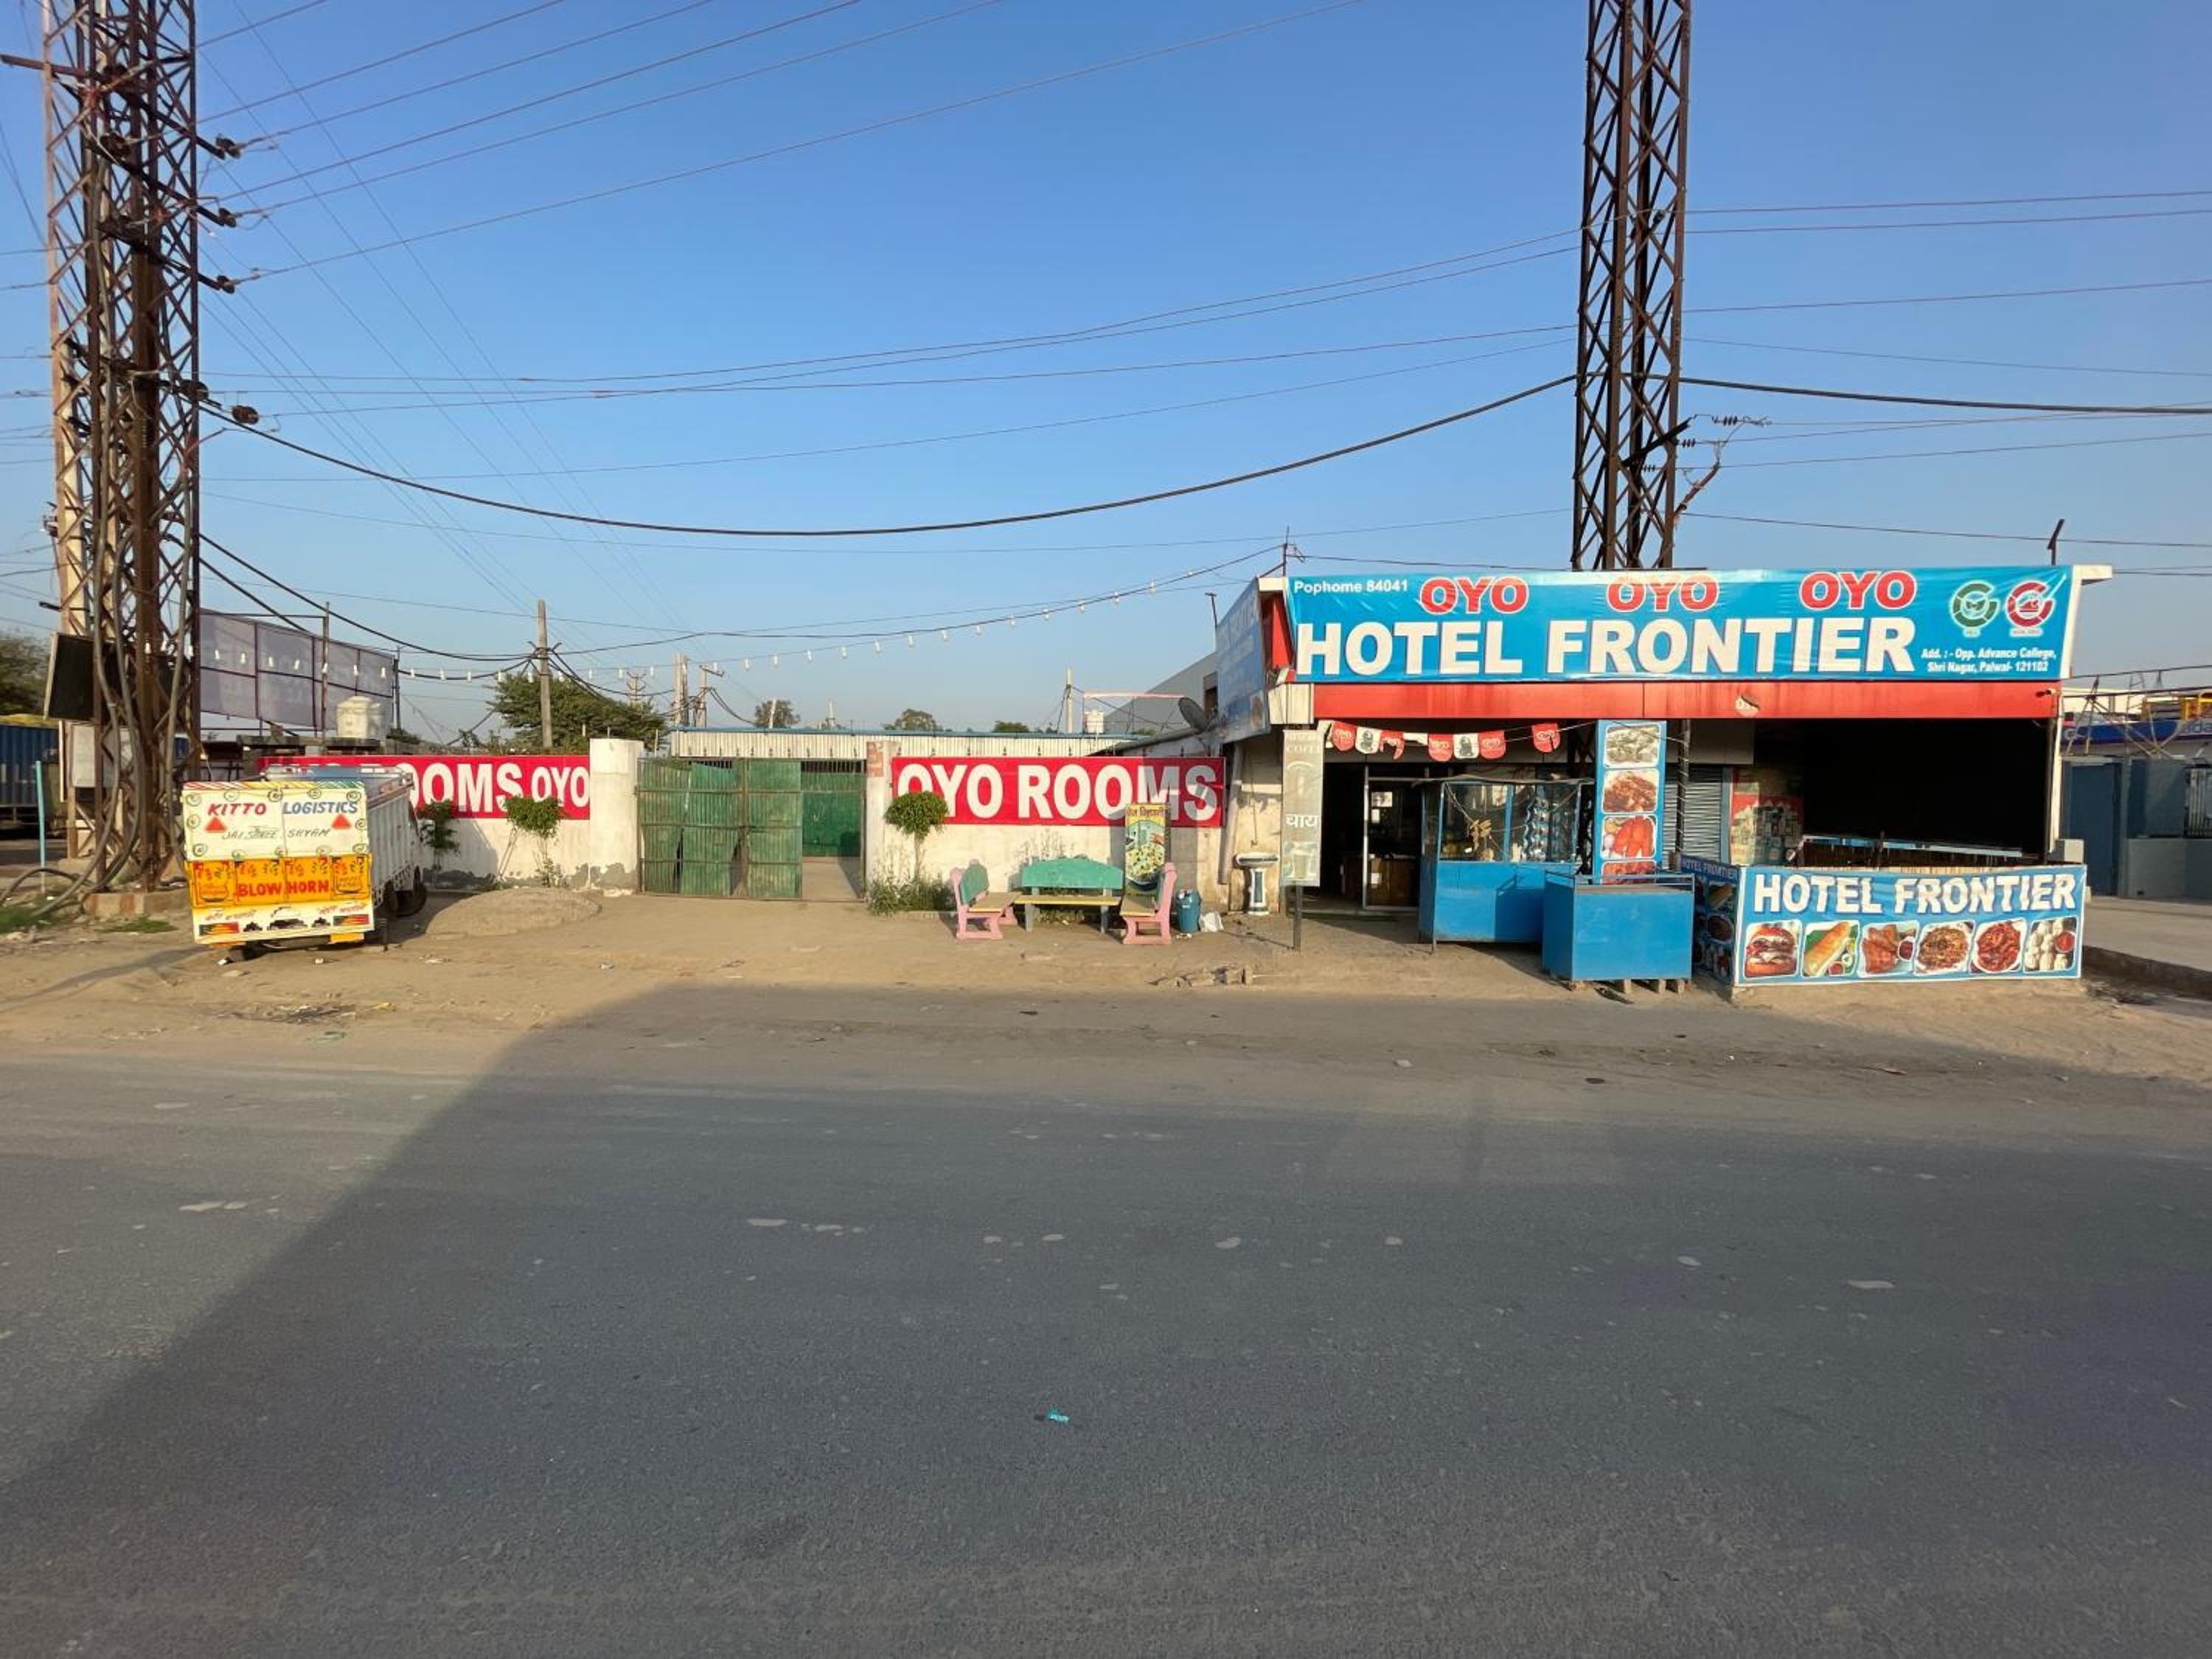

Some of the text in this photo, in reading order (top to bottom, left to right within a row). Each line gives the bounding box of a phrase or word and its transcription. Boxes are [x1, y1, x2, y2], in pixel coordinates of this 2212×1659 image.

[1294, 579, 1408, 596] Pophome 84041
[1420, 577, 1529, 614] OYO
[1607, 574, 1719, 612] OYO
[1800, 571, 1917, 611] OYO
[1296, 622, 1522, 677] HOTEL
[1547, 617, 1916, 675] FRONTIER
[1955, 648, 1975, 661] Opp.
[1978, 647, 2017, 658] Advance
[1927, 661, 1945, 672] Shri
[532, 767, 590, 808] OYO
[897, 764, 1217, 821] OYO ROOMS
[208, 801, 358, 815] KITTO LOGISTICS
[1286, 814, 1321, 828] चाय
[236, 883, 282, 897] BLOW
[287, 880, 330, 894] HORN
[1753, 872, 2076, 914] HOTEL FRONTIER
